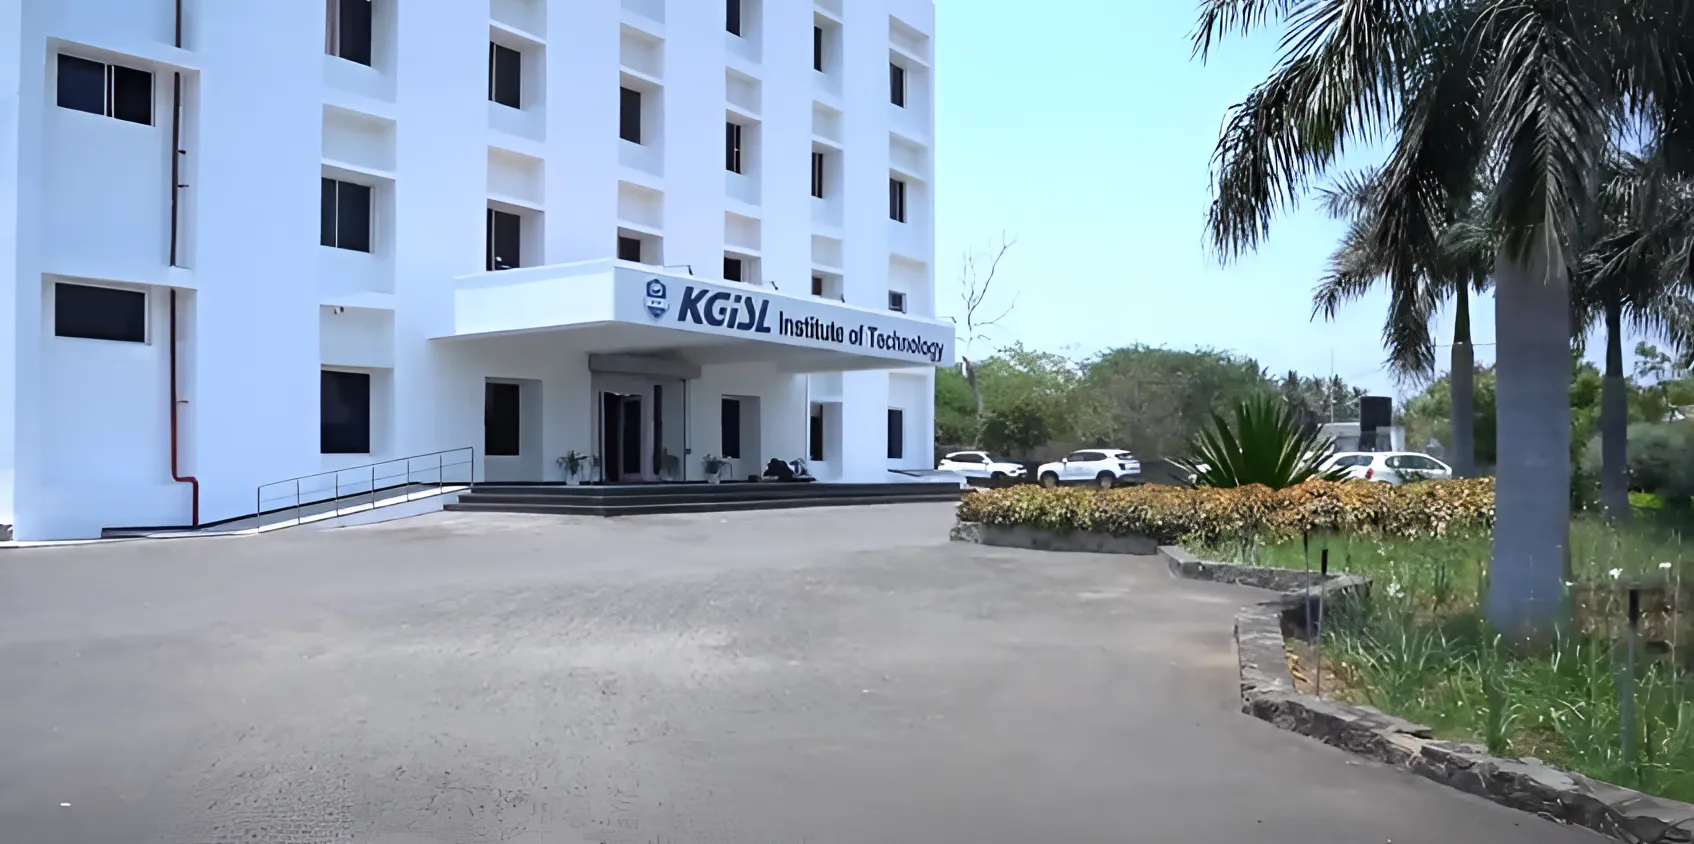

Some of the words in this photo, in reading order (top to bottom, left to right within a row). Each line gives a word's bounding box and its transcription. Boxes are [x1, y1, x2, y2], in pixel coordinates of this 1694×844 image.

[779, 310, 844, 344] Institute
[849, 324, 864, 346] of
[867, 326, 944, 363] Technology
